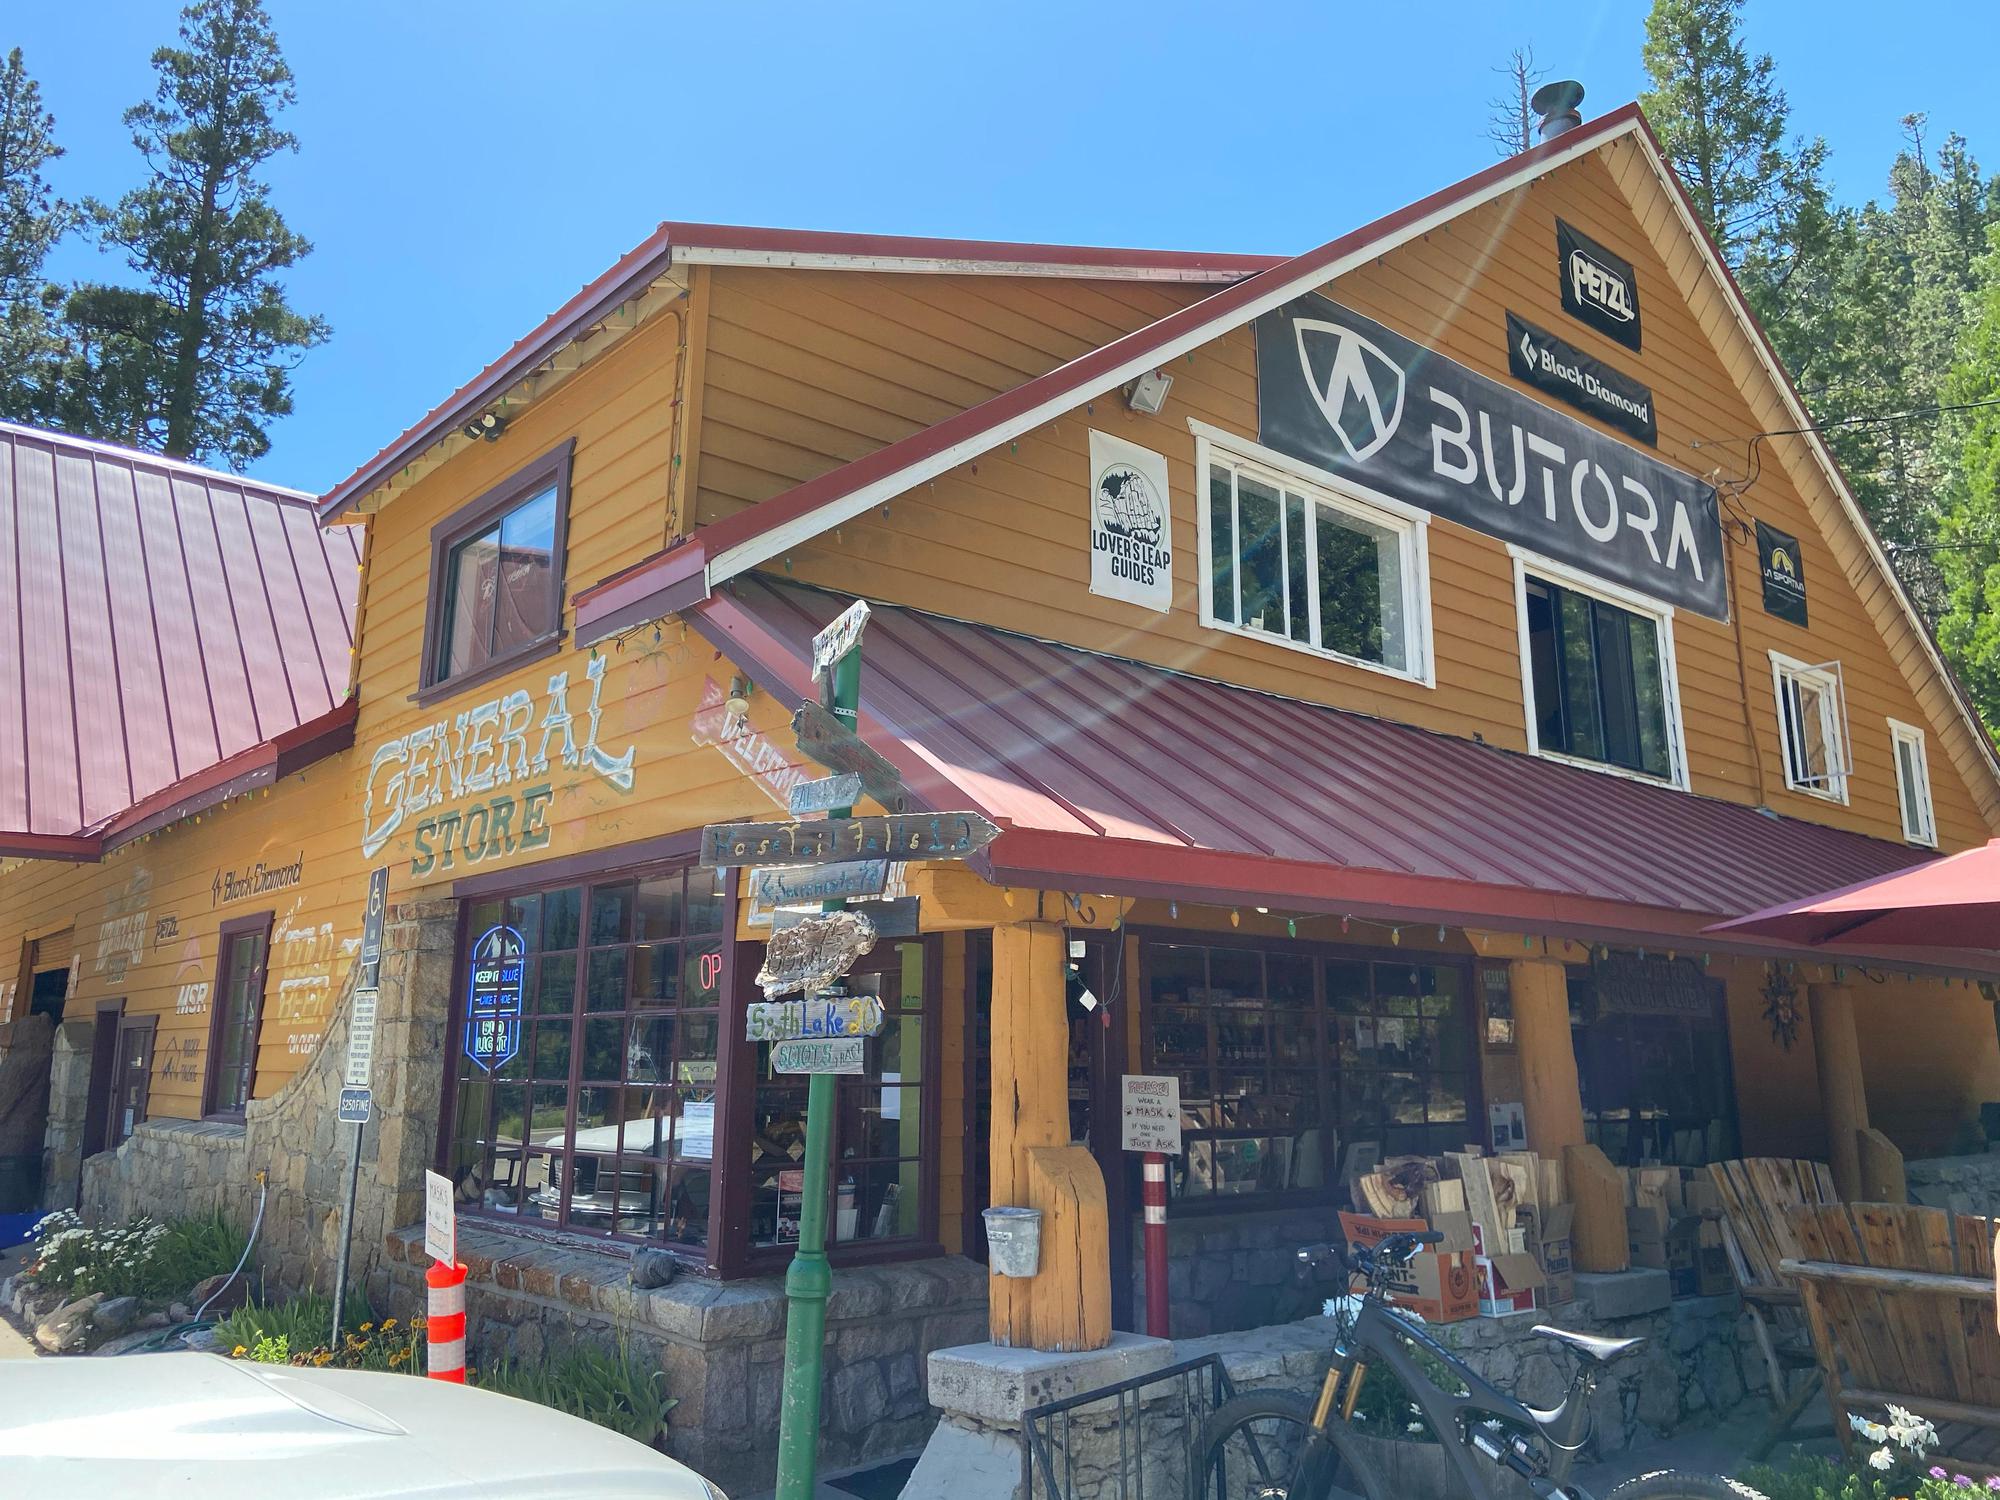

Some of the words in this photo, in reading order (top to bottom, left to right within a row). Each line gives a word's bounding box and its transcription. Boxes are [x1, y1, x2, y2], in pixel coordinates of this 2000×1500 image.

[1573, 255, 1635, 320] PETZL
[1541, 348, 1584, 389] Black
[1585, 373, 1648, 424] Diamond
[1429, 386, 1704, 582] BUTORA
[1092, 529, 1140, 560] LOVER'S
[1142, 548, 1171, 570] LEAP
[1111, 556, 1154, 586] GUIDES
[1774, 571, 1805, 592] SPORTIVA
[361, 654, 637, 860] GENERAL
[411, 783, 554, 879] STORE
[223, 866, 254, 903] Black
[254, 850, 304, 894] Diamond
[284, 922, 334, 978] COLD
[475, 970, 492, 983] KEEP
[700, 954, 722, 990] OP
[176, 983, 209, 1015] MSR
[278, 975, 331, 1026] BEER
[341, 1099, 356, 1112] $250
[356, 1098, 369, 1112] FINE
[1136, 1107, 1165, 1118] MASK
[1138, 1097, 1154, 1105] WEAR
[1130, 1139, 1151, 1149] JUST
[1156, 1139, 1176, 1150] ASK
[1139, 1123, 1151, 1131] YOU
